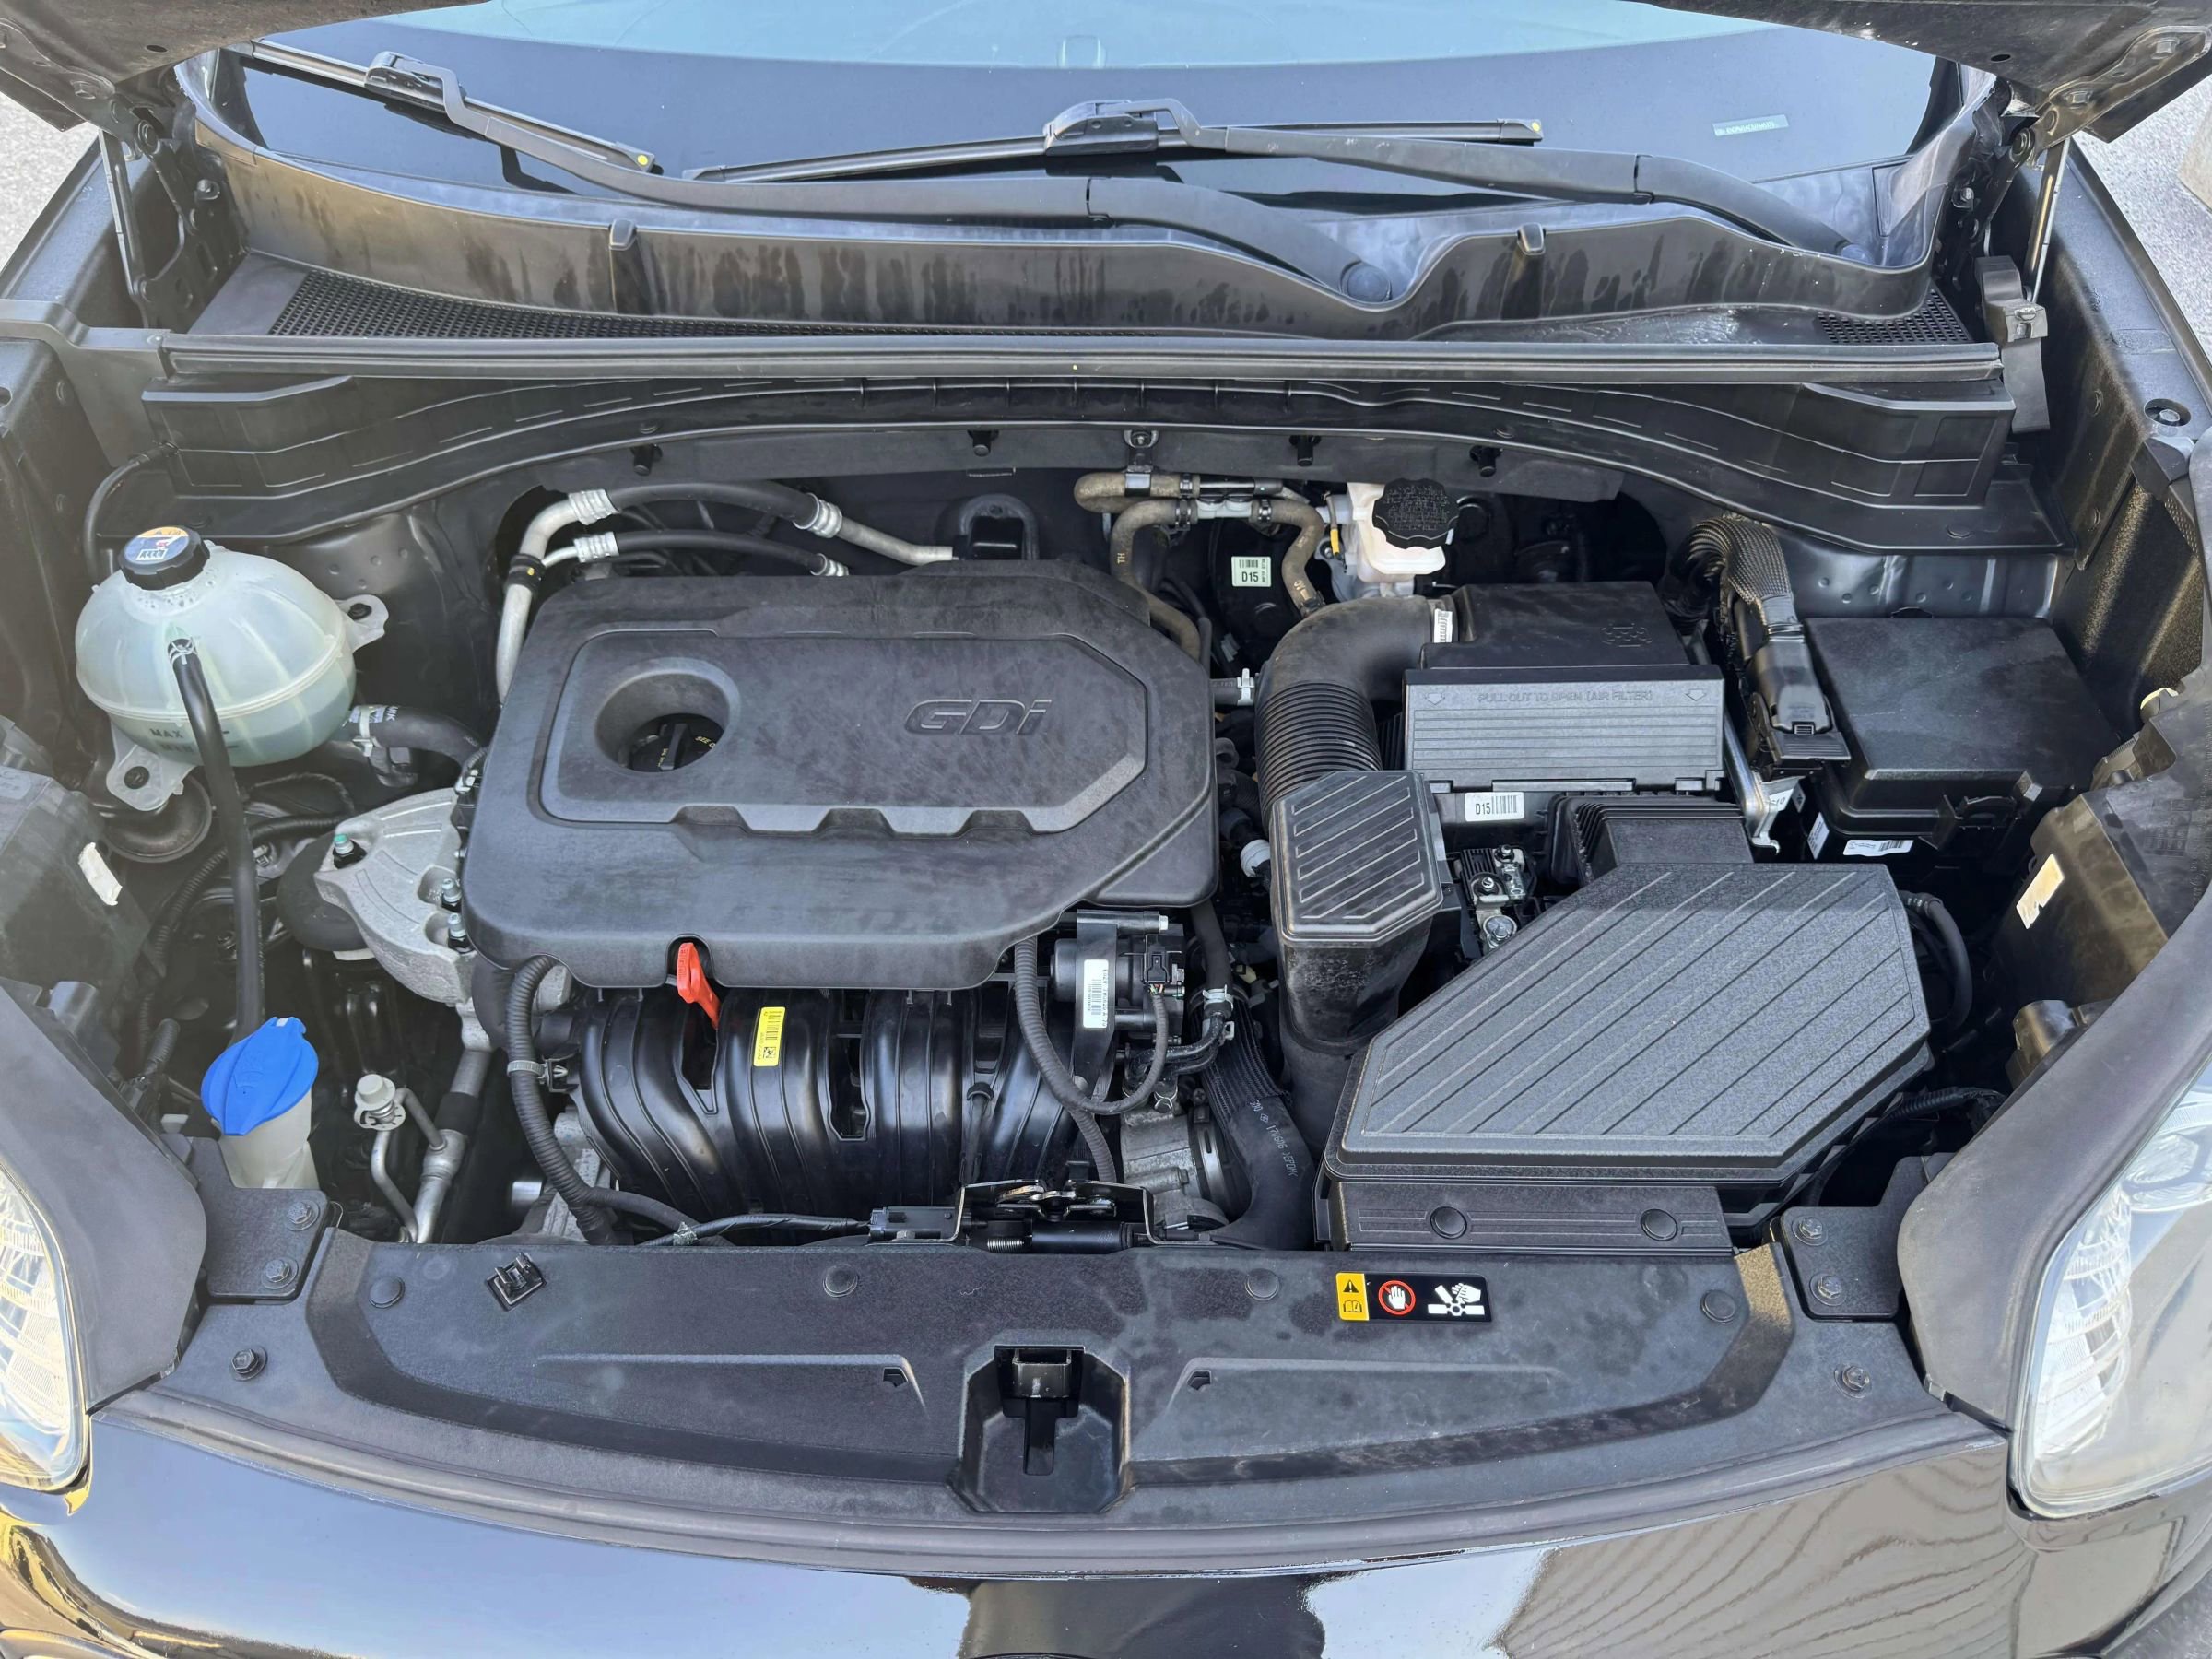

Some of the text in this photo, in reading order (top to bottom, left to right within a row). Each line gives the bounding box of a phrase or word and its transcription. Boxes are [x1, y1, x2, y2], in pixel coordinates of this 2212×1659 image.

[1241, 571, 1259, 582] D15
[1508, 692, 1531, 702] OUT
[1535, 692, 1548, 702] TO
[904, 699, 1052, 735] GDi
[148, 728, 184, 738] MAX
[1475, 802, 1491, 815] D15
